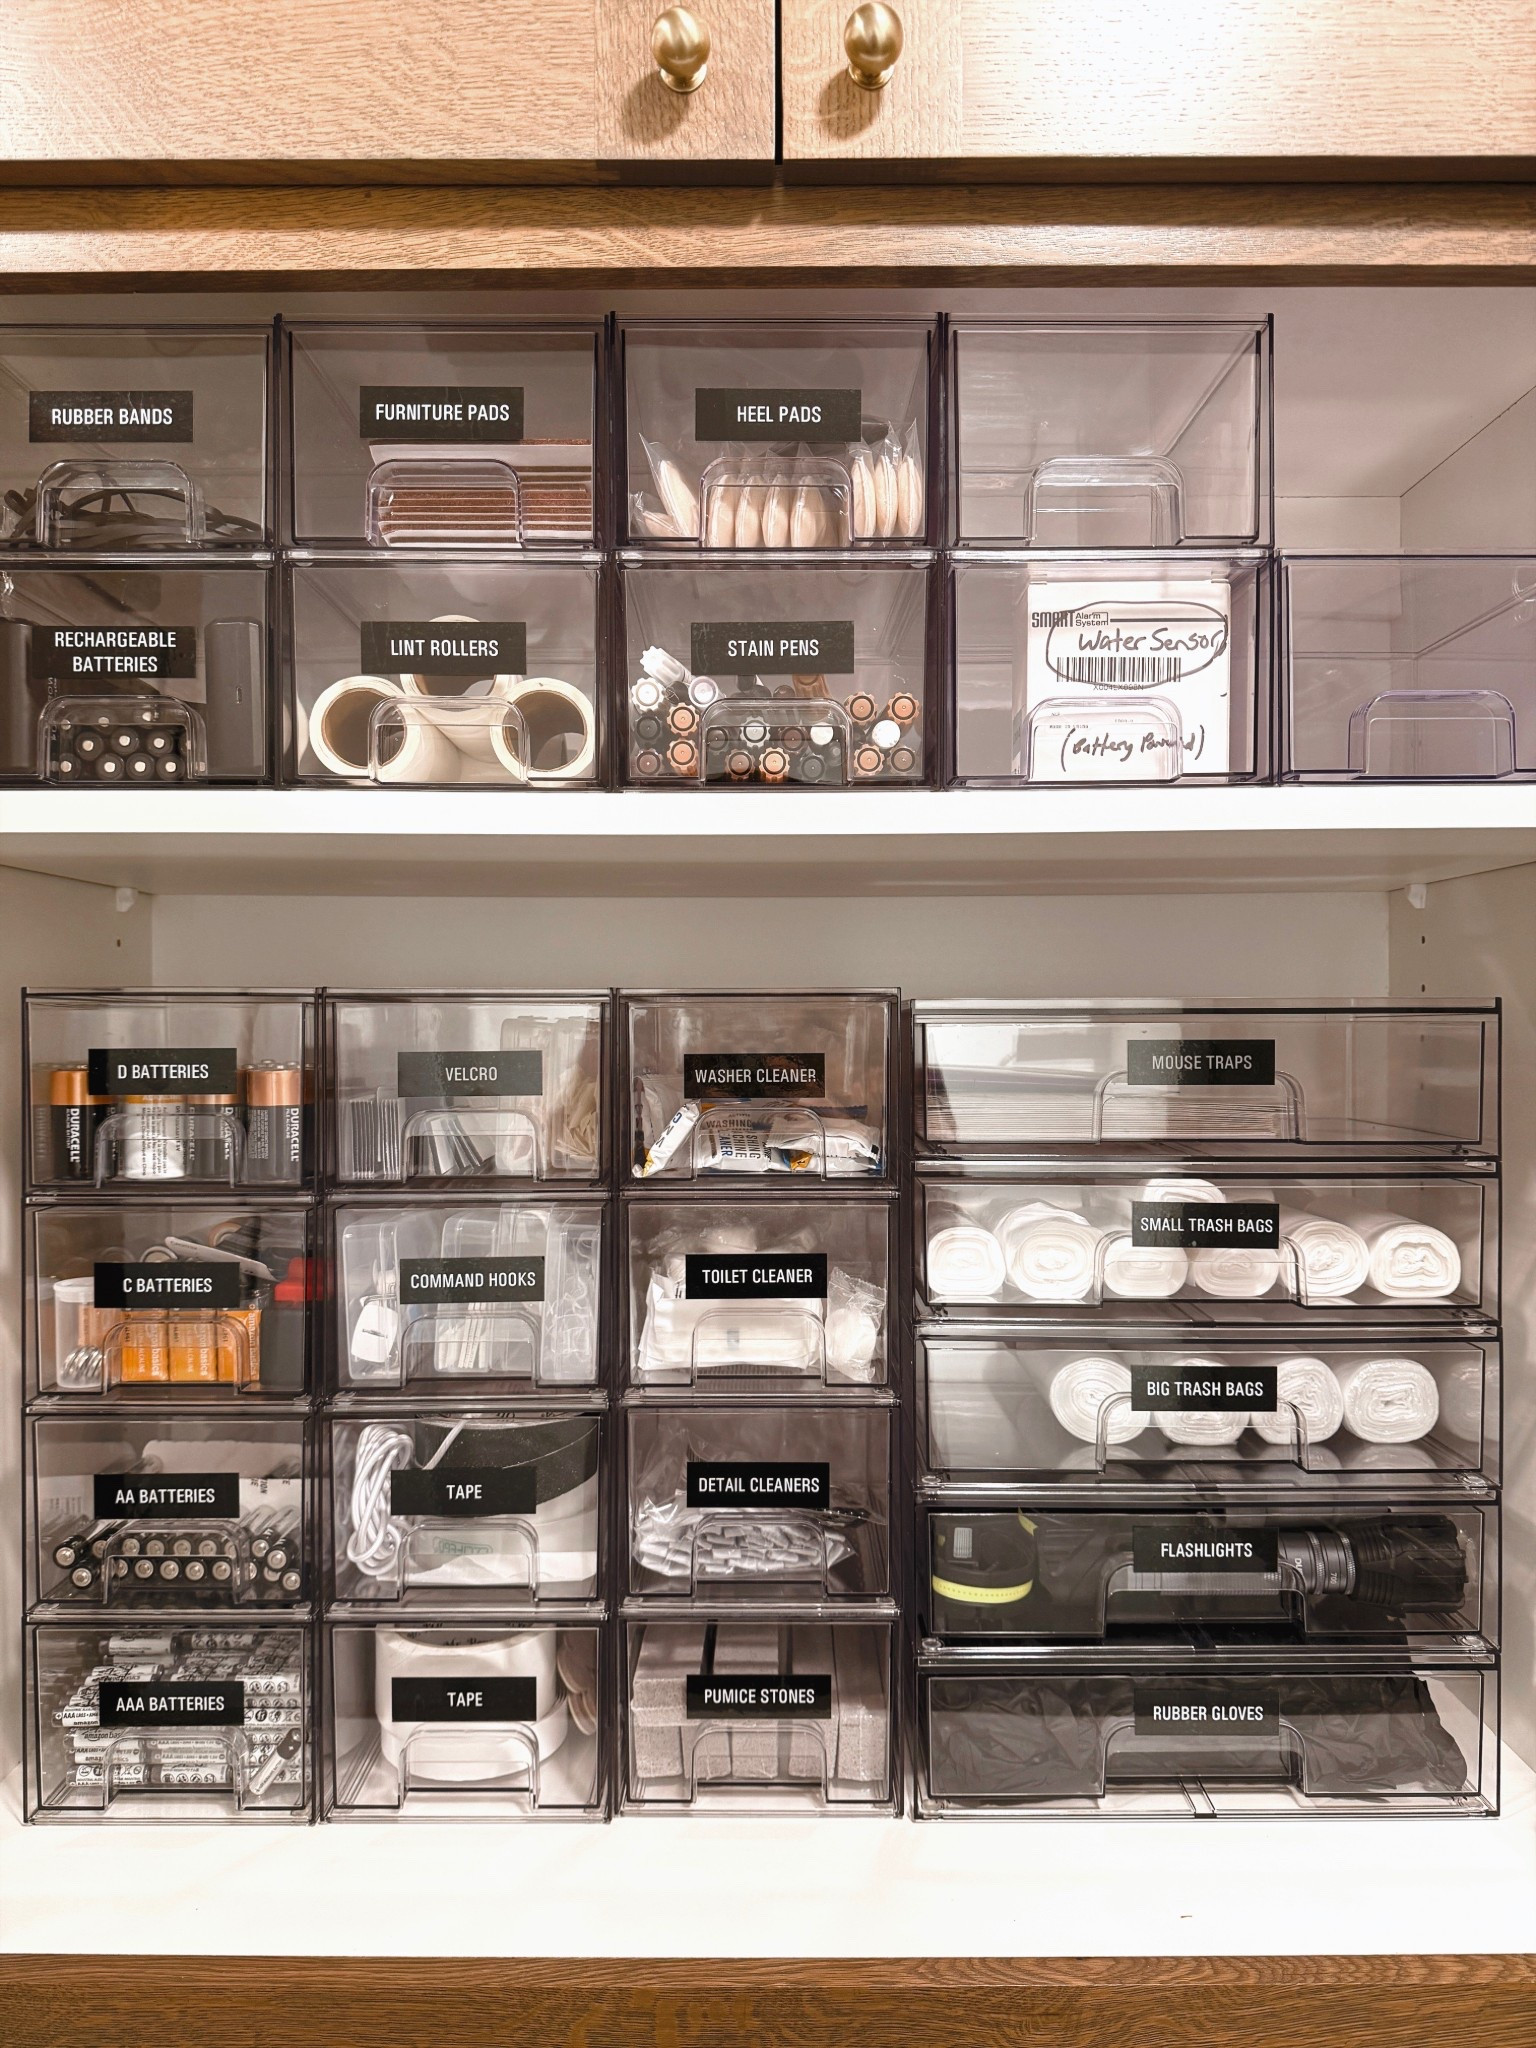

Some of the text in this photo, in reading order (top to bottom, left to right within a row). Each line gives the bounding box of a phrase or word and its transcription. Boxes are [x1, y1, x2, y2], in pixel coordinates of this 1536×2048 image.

[51, 407, 173, 426] RUBBER BANDS
[375, 403, 510, 422] FURNITURE PADS
[737, 405, 822, 423] HEEL PADS
[1032, 612, 1075, 628] SMART
[1075, 619, 1108, 627] System
[54, 631, 177, 648] RECHARGEABLE
[727, 638, 819, 657] STAIN PENS
[1078, 627, 1224, 652] Water Sensor
[390, 639, 499, 657] LINT ROLLERS
[72, 656, 158, 673] BATTERIES
[1152, 1055, 1253, 1070] MOUSE TRAPS
[117, 1063, 209, 1079] D BATTERIES
[445, 1066, 498, 1082] VELCRO
[695, 1068, 817, 1084] WASHER CLEANER
[706, 1119, 753, 1129] WASHING
[70, 1108, 80, 1162] DURACELL
[290, 1107, 300, 1162] DURACELL
[1140, 1216, 1273, 1233] SMALL TRASH BAGS
[410, 1271, 536, 1289] COMMAND HOOKS
[701, 1268, 813, 1284] TOILET CLEANER
[123, 1277, 213, 1293] C BATTERIES
[1147, 1381, 1264, 1397] BIG TRASH BAGS
[446, 1484, 482, 1500] TAPE
[699, 1477, 820, 1493] DETAIL CLEANERS
[115, 1488, 215, 1504] AA BATTERIES
[1161, 1542, 1253, 1558] FLASHLIGHTS
[116, 1696, 225, 1712] AAA BATTERIES
[447, 1692, 483, 1707] TAPE
[704, 1688, 815, 1704] PUMICE STONES
[1153, 1705, 1264, 1721] RUBBER GLOVES
